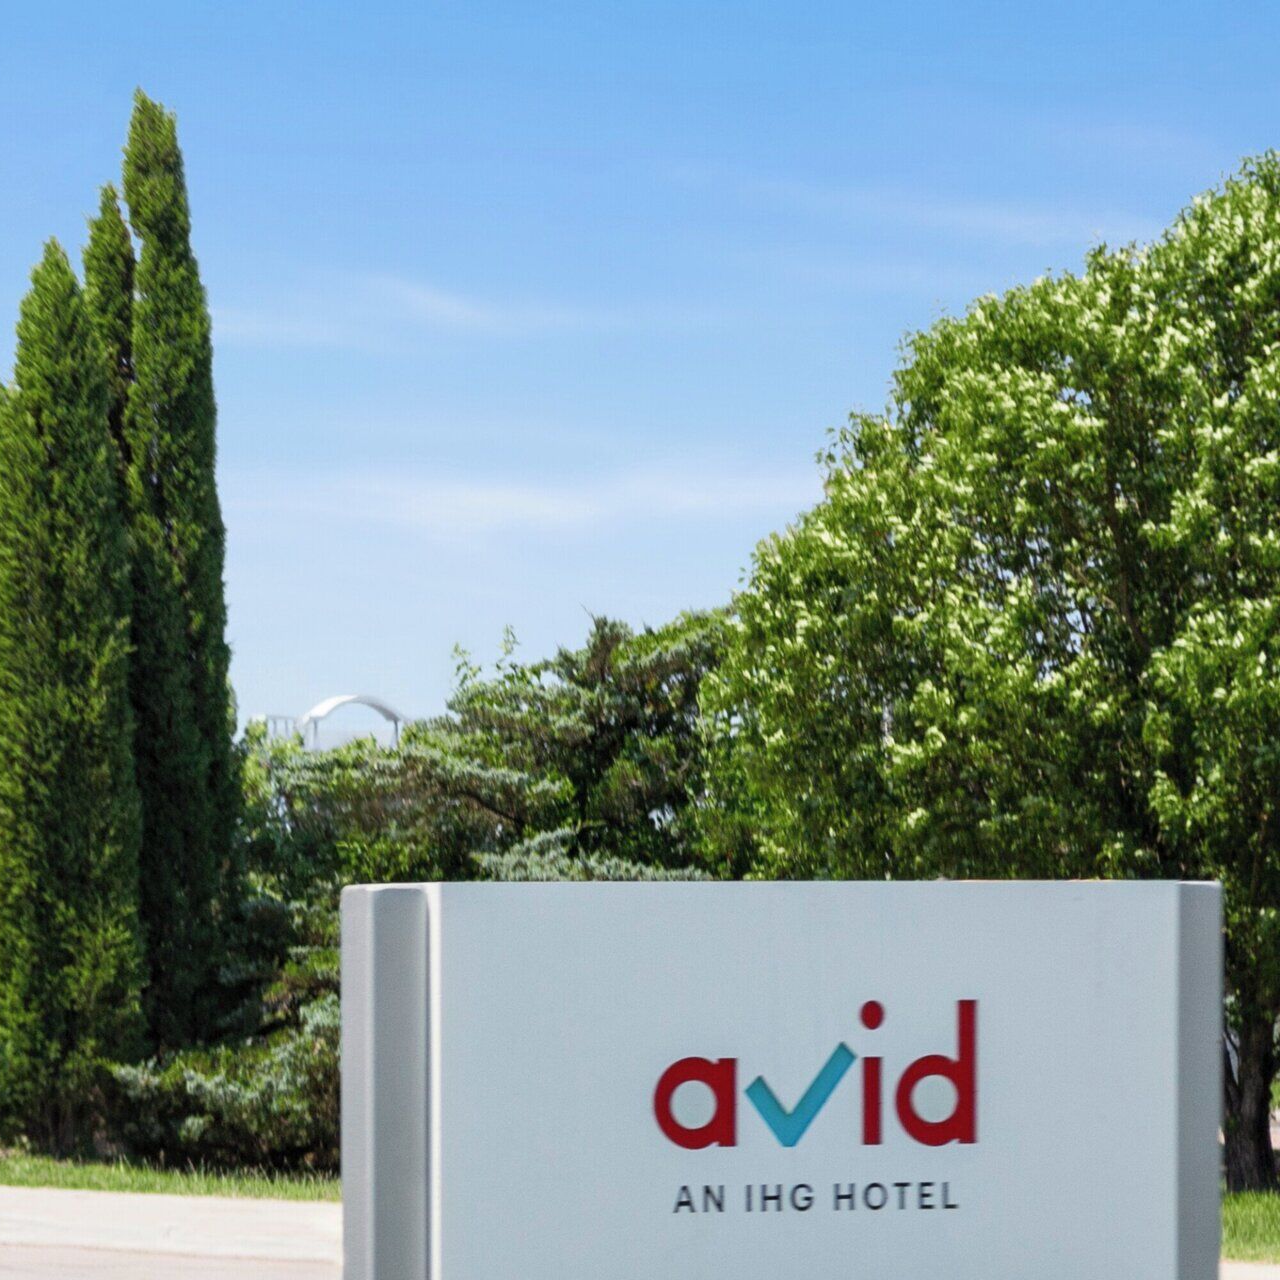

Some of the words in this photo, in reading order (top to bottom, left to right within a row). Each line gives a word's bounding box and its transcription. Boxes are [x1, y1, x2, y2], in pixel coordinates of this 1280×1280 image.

[653, 999, 978, 1150] avid
[673, 1184, 725, 1213] AN
[745, 1183, 815, 1212] IHG
[833, 1181, 960, 1211] HOTEL
